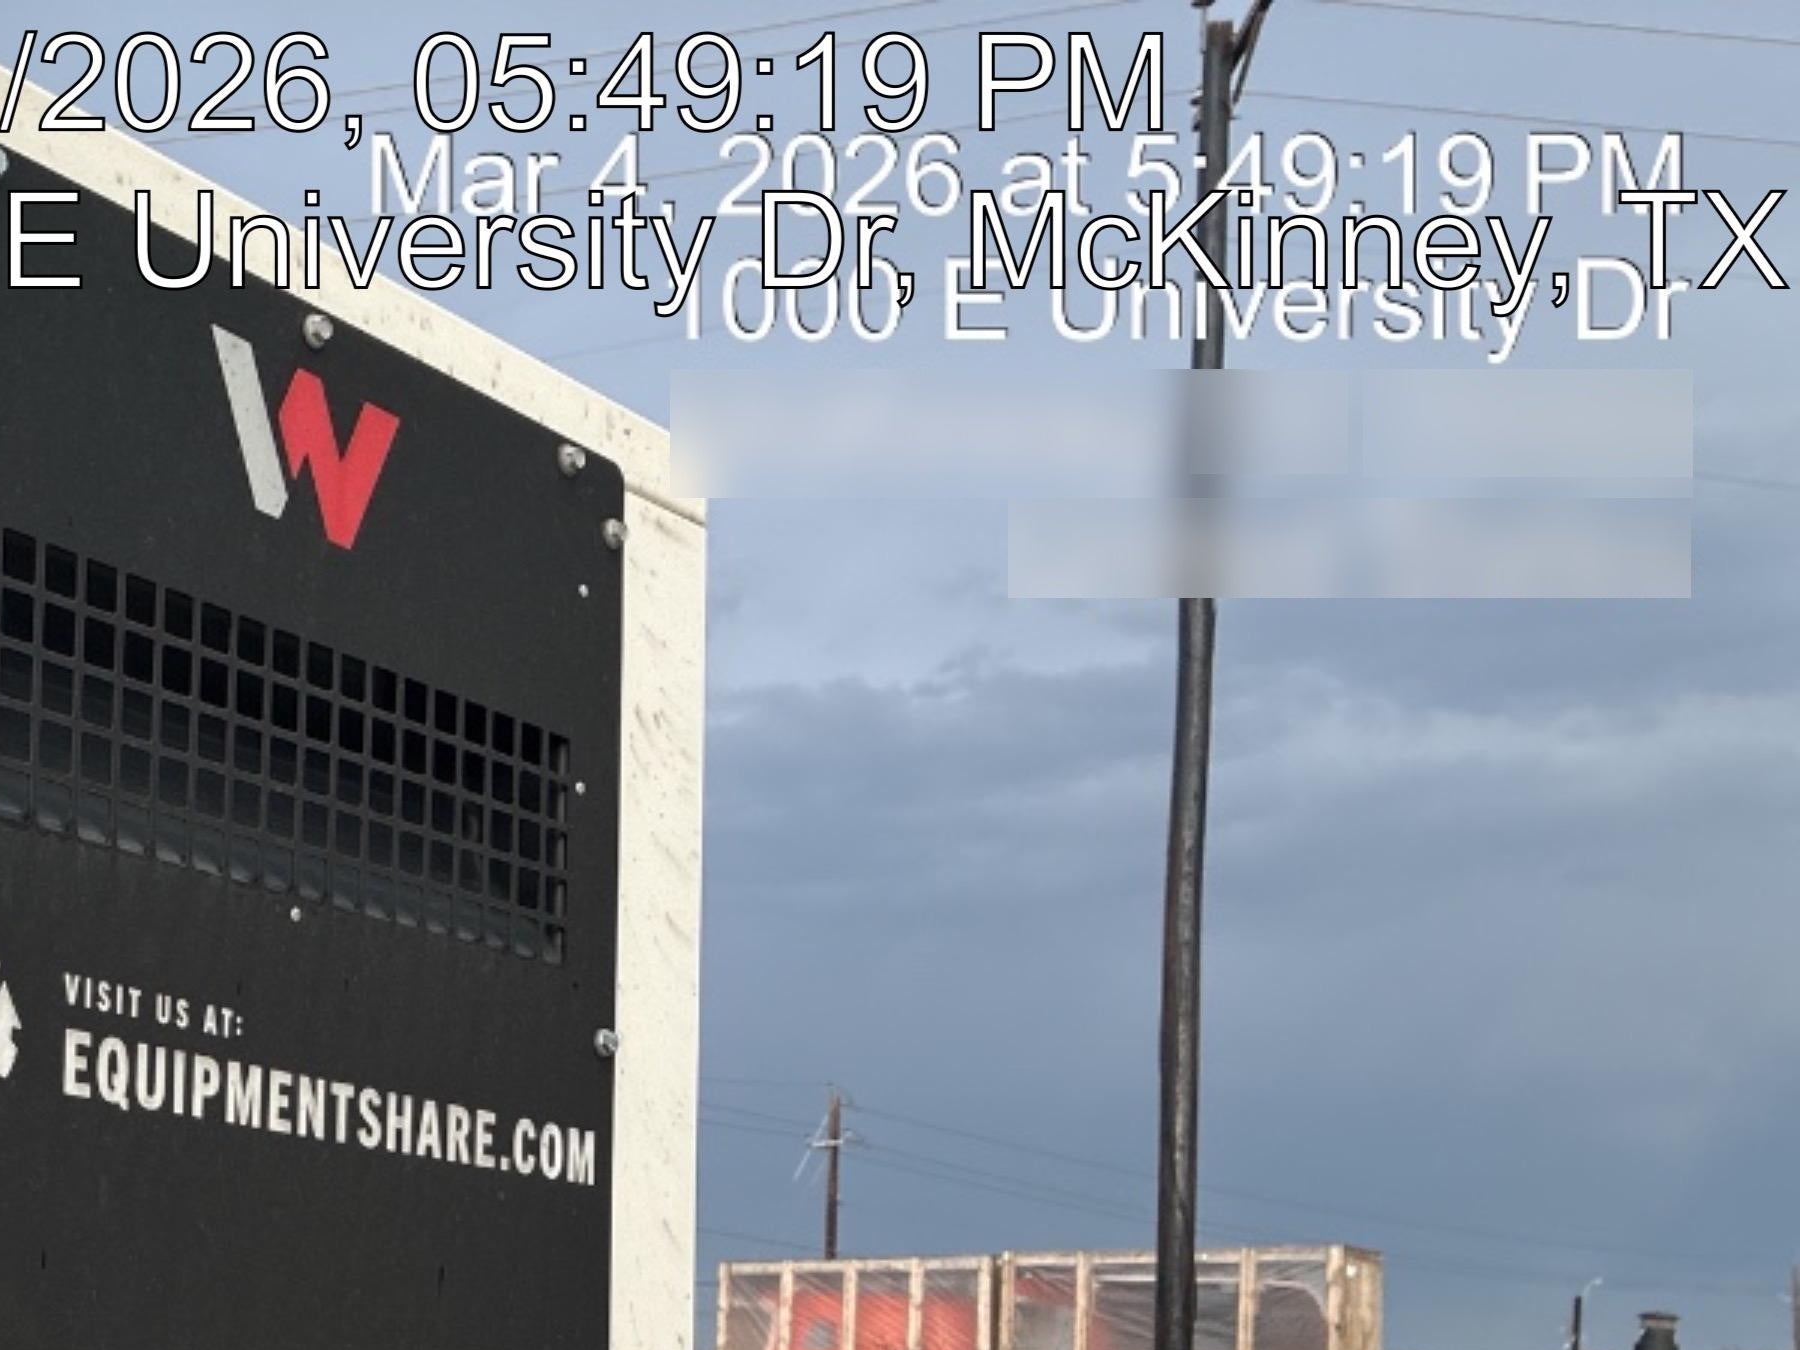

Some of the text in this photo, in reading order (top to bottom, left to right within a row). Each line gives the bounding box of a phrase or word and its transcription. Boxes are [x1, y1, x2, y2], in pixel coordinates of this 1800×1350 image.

[63, 972, 244, 1039] VISIT US AT:
[62, 1028, 596, 1186] EQUIPMENTSHARE.COM
